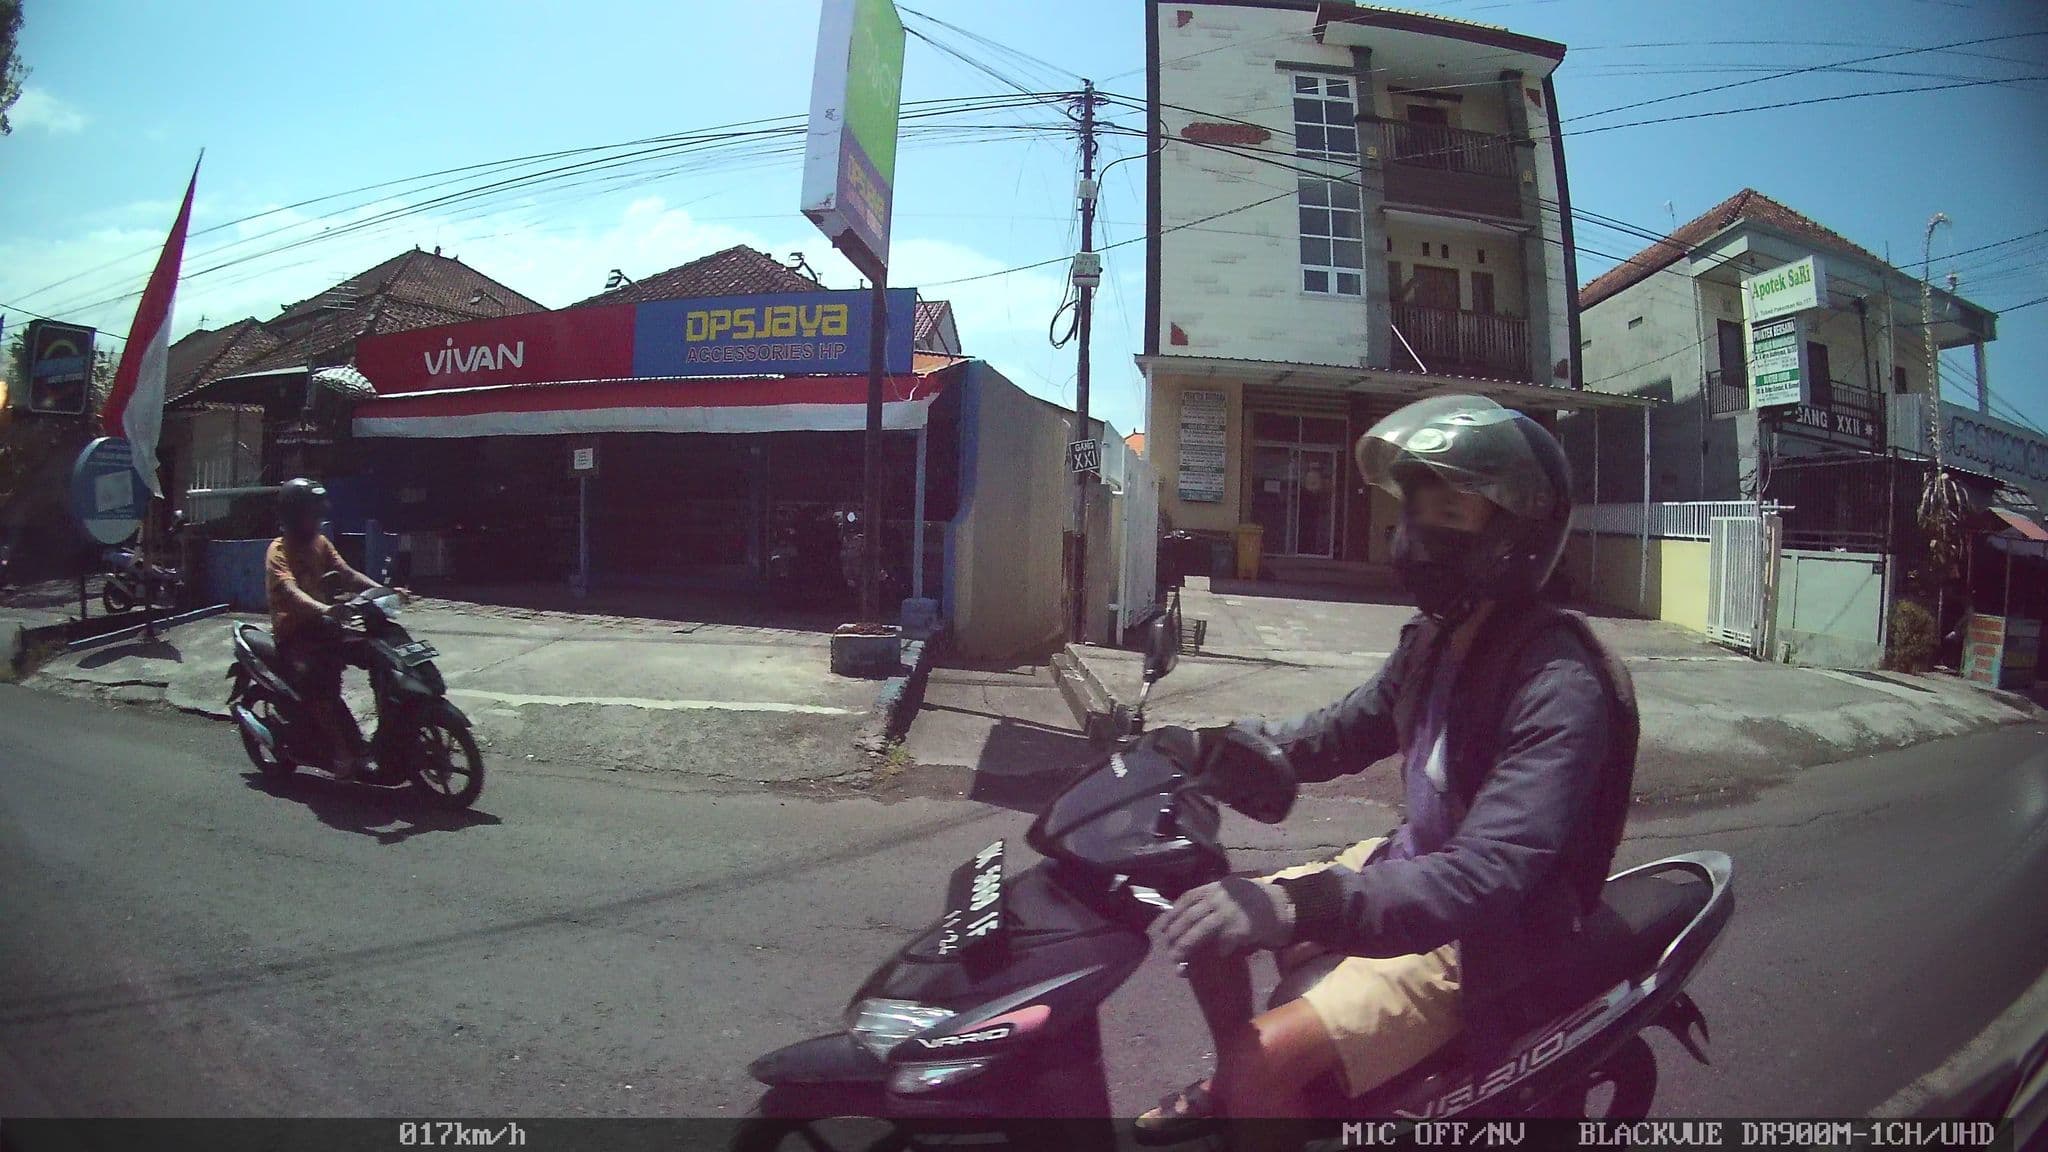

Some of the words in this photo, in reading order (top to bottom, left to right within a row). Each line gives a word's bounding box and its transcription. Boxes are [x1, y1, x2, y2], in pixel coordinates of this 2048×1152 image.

[1752, 272, 1787, 301] Apotek
[686, 343, 814, 364] ACCESSORIES
[818, 342, 846, 360] HP
[1074, 450, 1096, 470] XXI
[1394, 1032, 1565, 1119] VARIO
